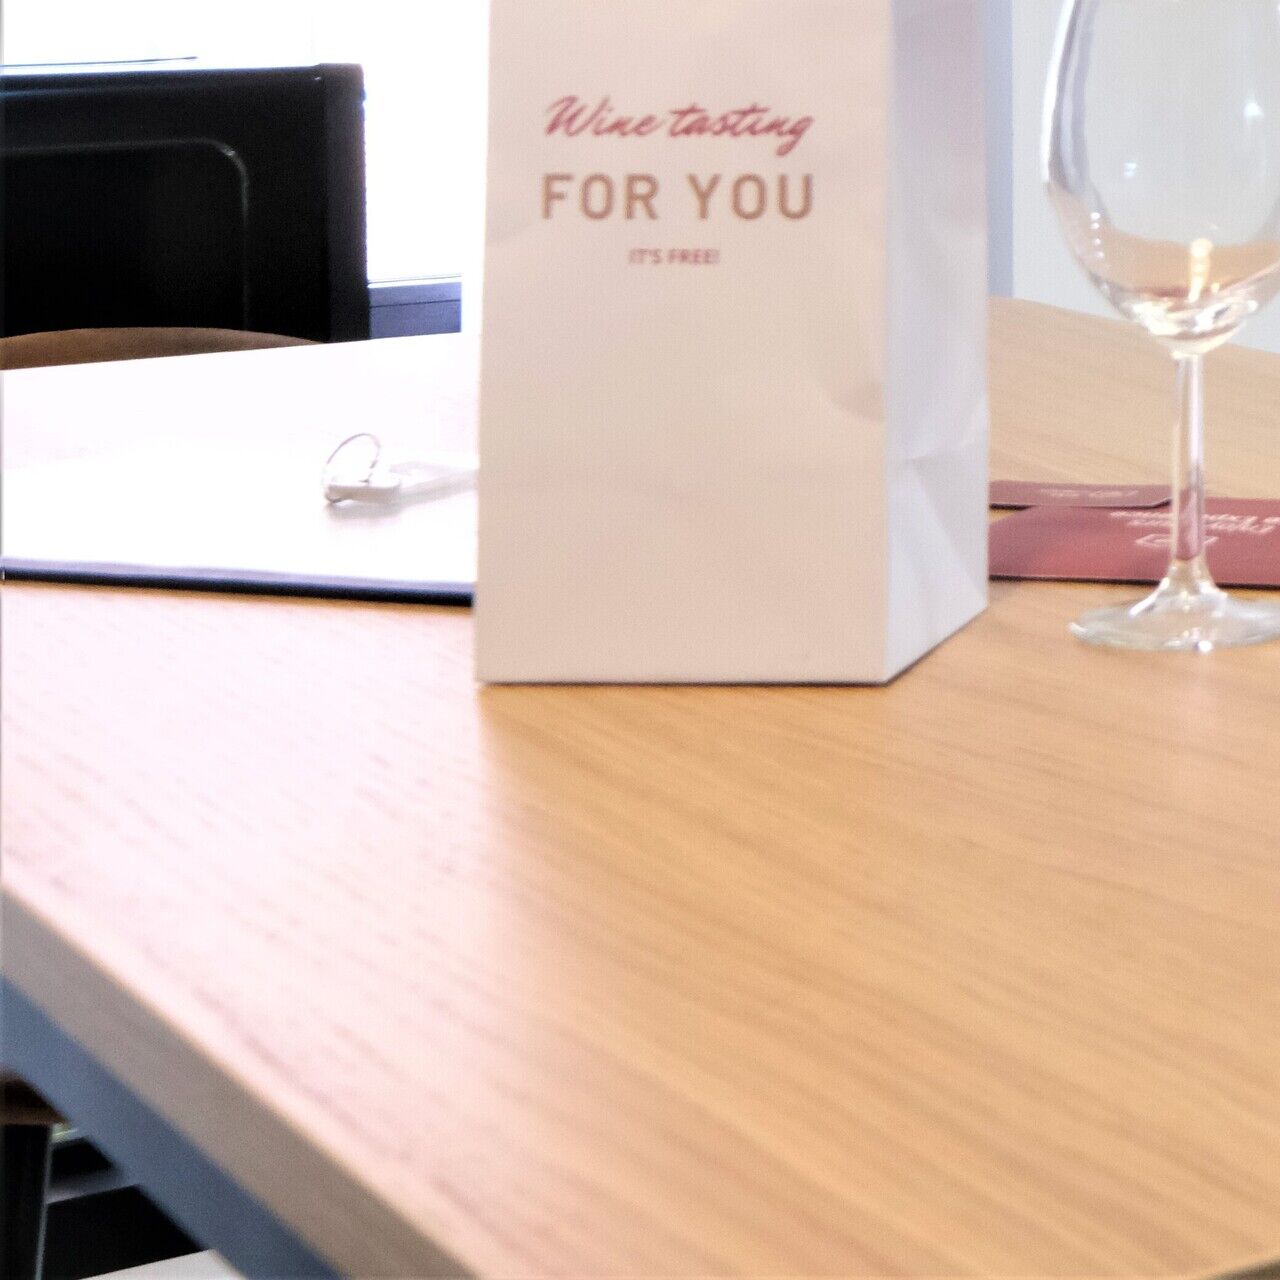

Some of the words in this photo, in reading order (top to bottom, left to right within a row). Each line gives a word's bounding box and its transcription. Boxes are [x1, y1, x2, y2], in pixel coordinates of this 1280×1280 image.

[545, 95, 663, 137] Wine
[667, 103, 814, 157] tasting
[541, 172, 660, 220] FOR
[685, 172, 814, 221] YOU
[629, 248, 662, 264] IT'S
